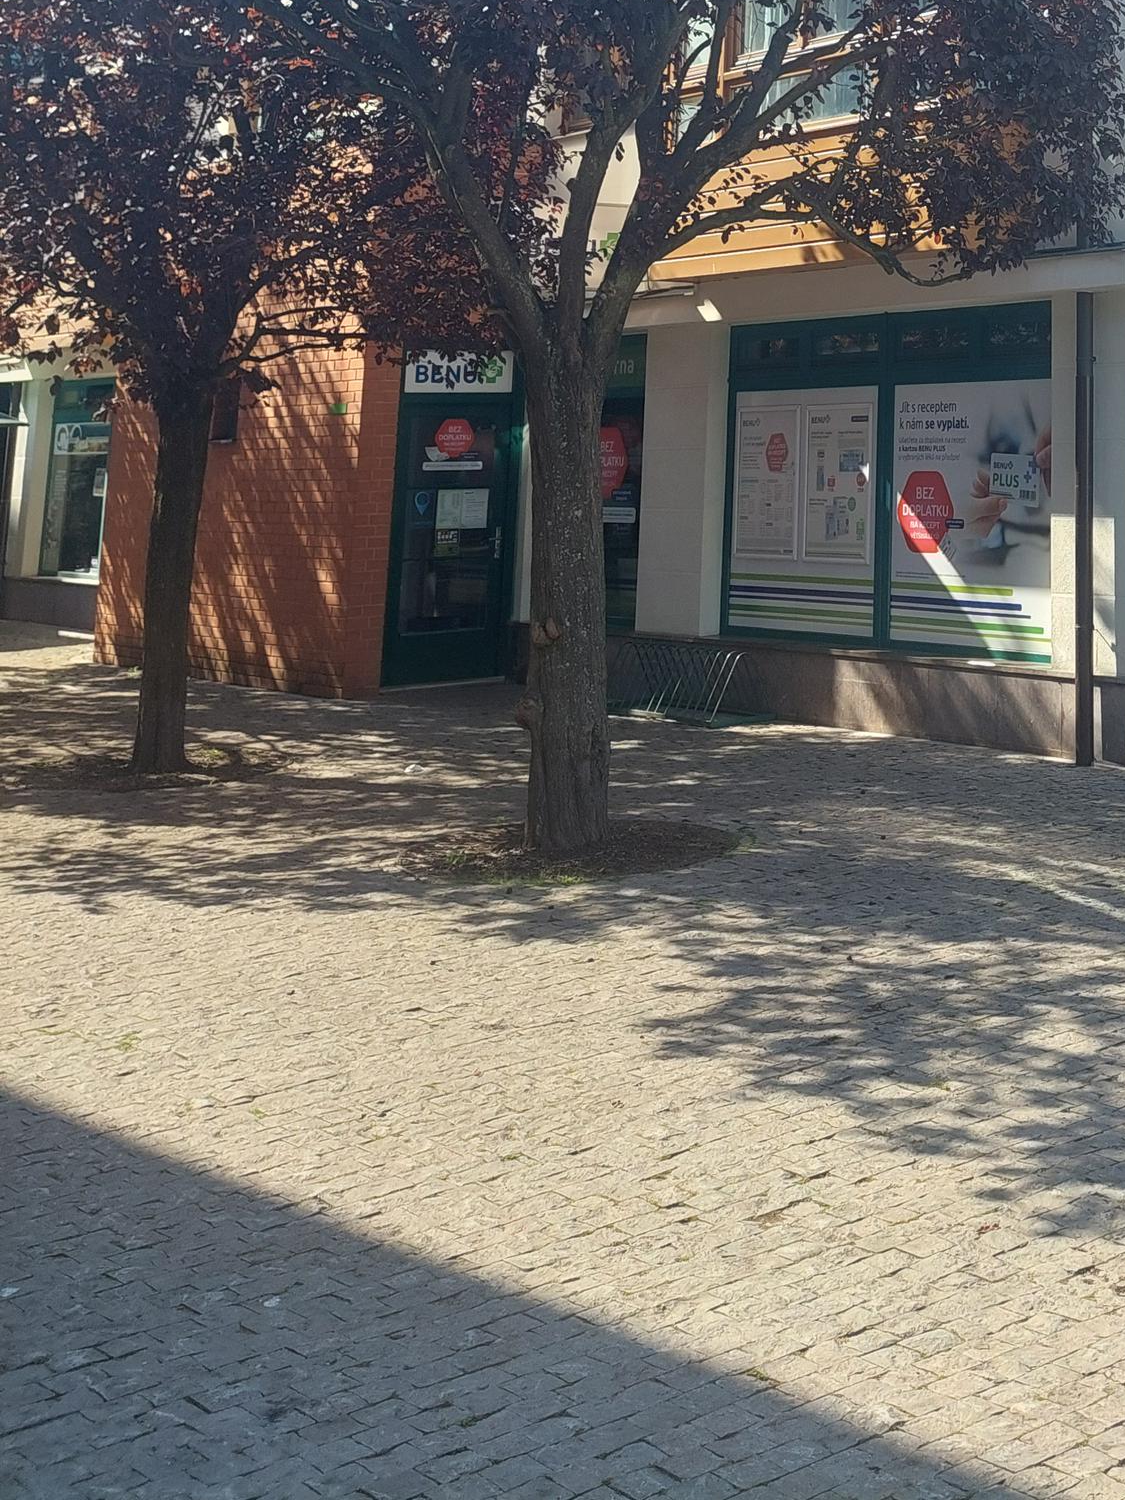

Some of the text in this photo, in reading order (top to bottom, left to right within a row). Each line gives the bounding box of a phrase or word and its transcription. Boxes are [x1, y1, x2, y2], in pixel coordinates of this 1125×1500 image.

[415, 364, 477, 384] BENU
[911, 403, 916, 413] s
[917, 400, 957, 415] receptem
[899, 415, 970, 432] k nám se vyplatí.
[600, 441, 615, 452] BEZ
[993, 473, 1019, 488] PLUS
[916, 486, 935, 500] BEZ
[902, 503, 949, 517] DOPLATKU
